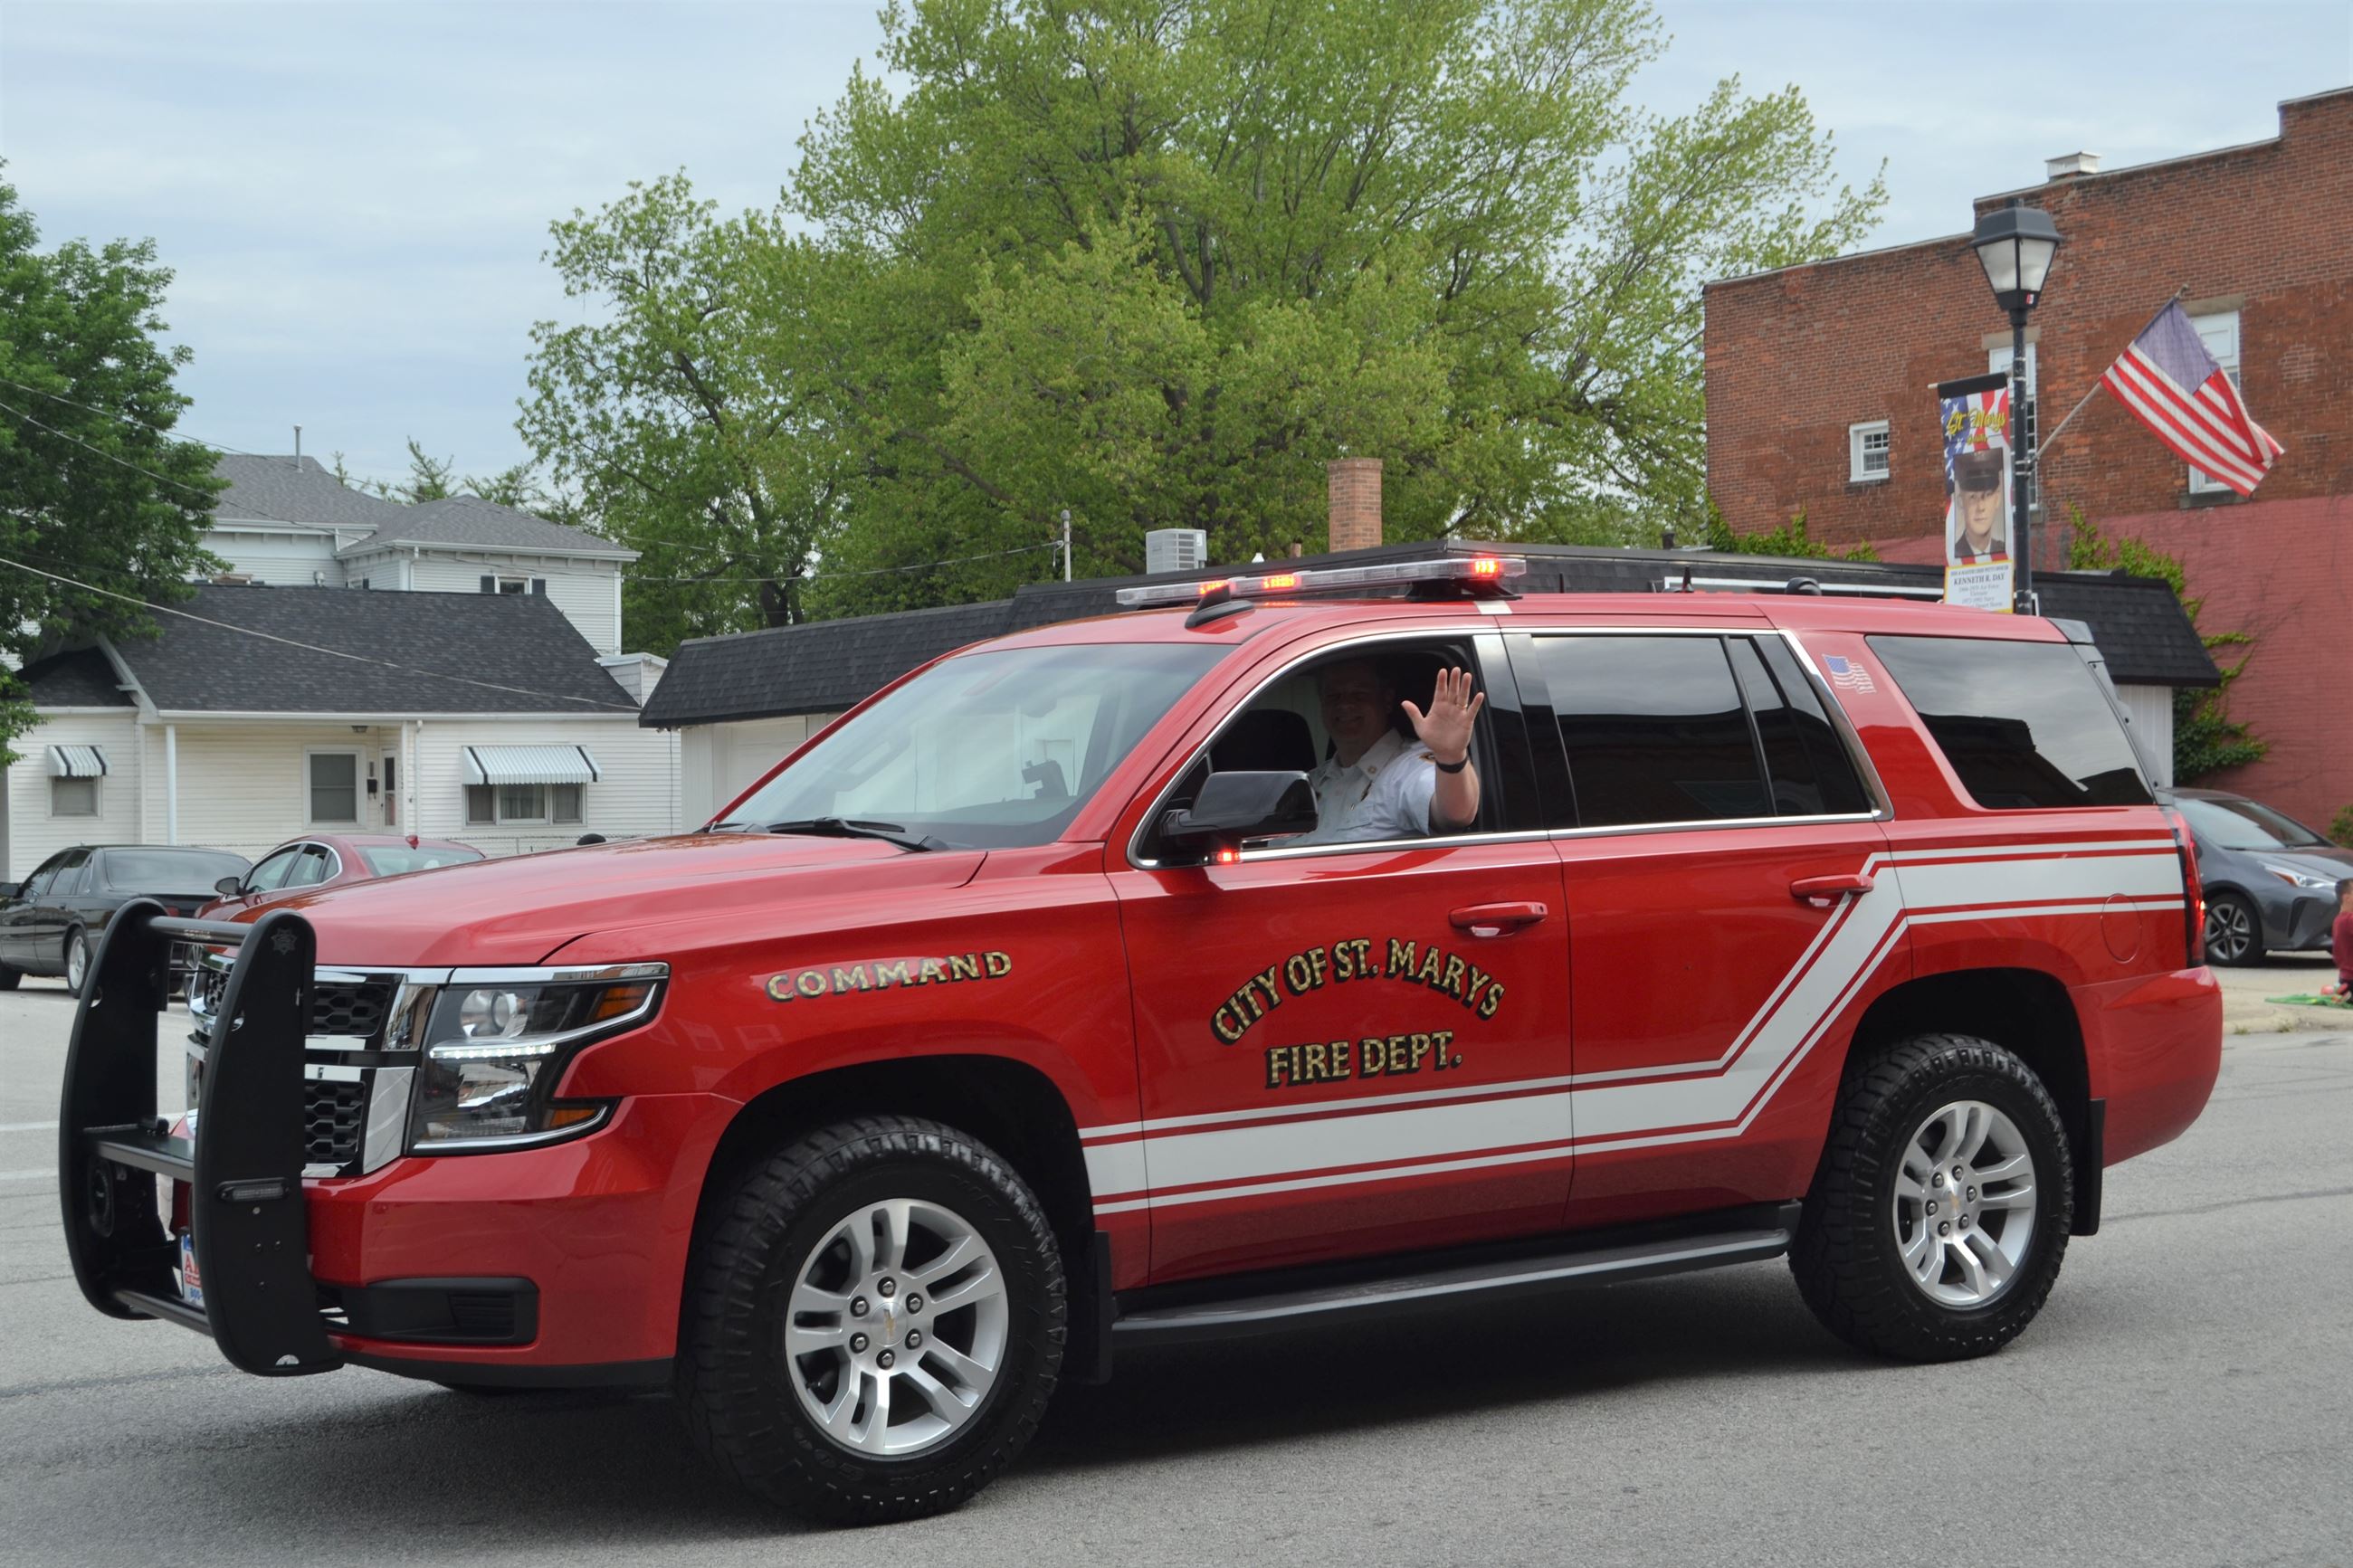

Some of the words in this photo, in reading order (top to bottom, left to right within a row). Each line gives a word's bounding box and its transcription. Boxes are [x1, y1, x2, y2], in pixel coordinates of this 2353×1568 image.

[1967, 407, 2005, 432] Marys
[1954, 575, 1985, 585] KENNETH
[1993, 573, 2005, 582] DAY
[766, 951, 1013, 1003] COMMAND
[1211, 964, 1282, 1045] CITY
[1282, 946, 1328, 997] OF
[1330, 937, 1379, 983] ST.
[1386, 937, 1506, 1021] MARYS
[1265, 1040, 1351, 1088] FIRE
[1359, 1030, 1463, 1079] DEPT.
